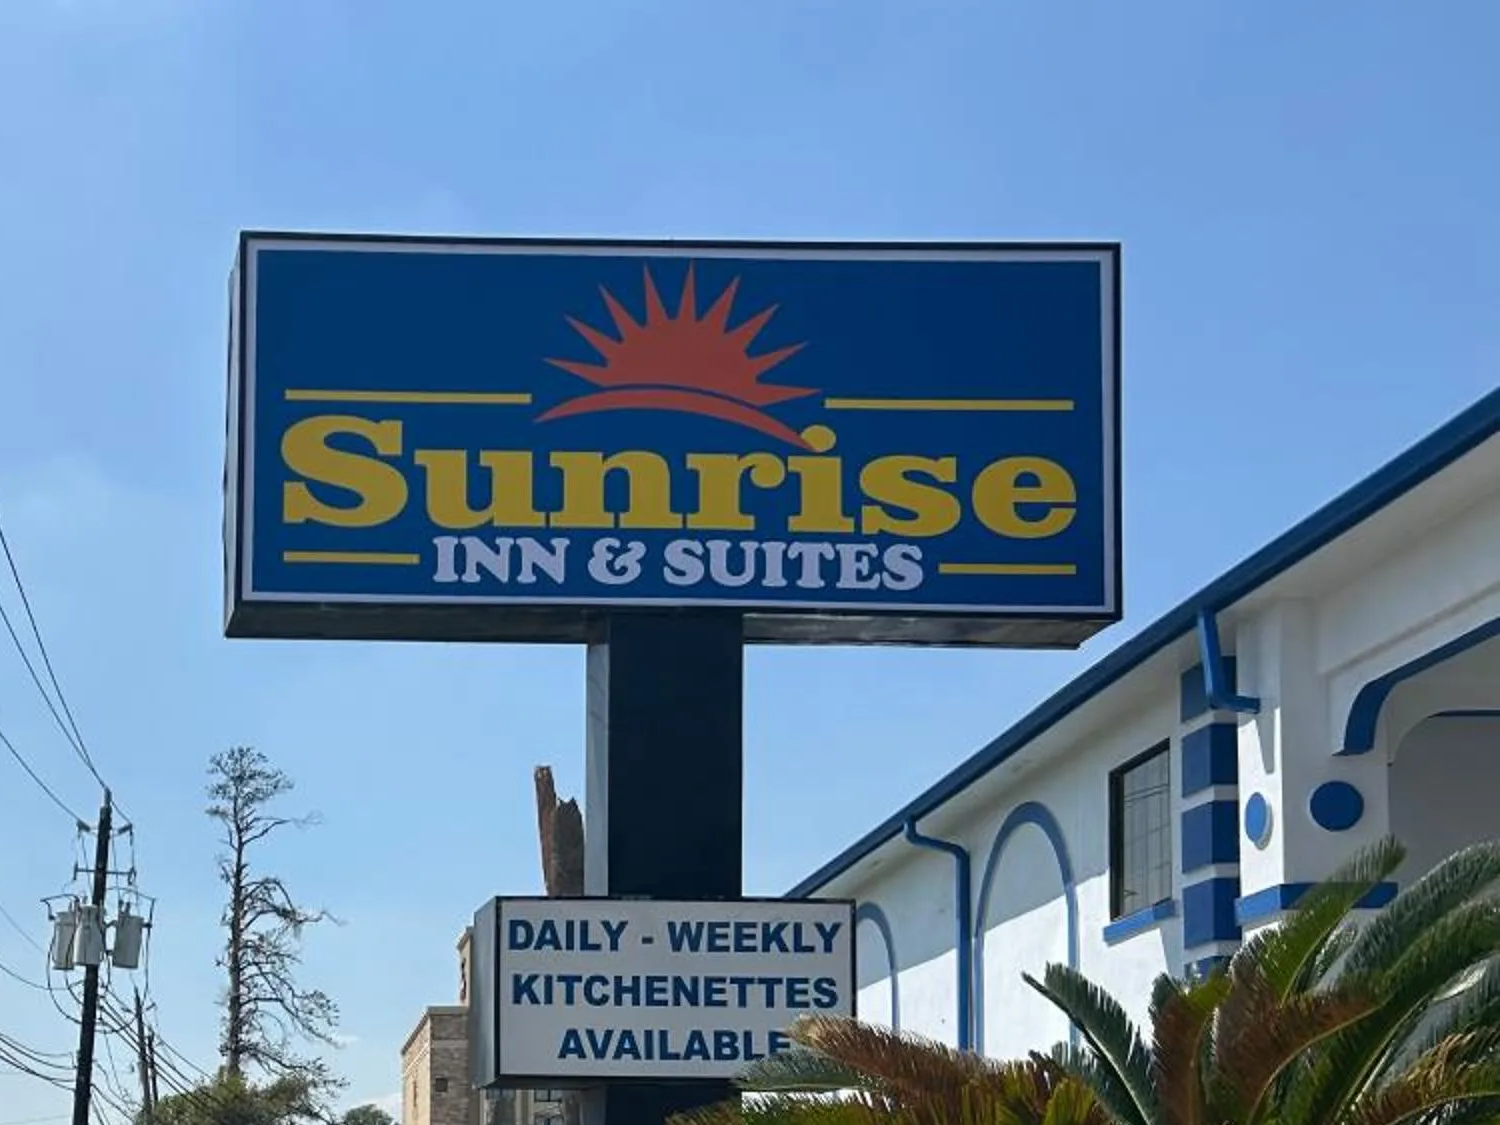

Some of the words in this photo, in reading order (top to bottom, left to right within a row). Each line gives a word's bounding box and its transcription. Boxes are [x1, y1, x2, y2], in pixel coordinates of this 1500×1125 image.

[281, 414, 1077, 539] Sunrise
[432, 536, 570, 584] INN
[588, 537, 645, 583] &
[664, 540, 924, 589] SUITES
[508, 919, 628, 952] DAILY
[667, 921, 843, 954] WEEKLY
[512, 974, 839, 1009] KITCHENETTES
[557, 1028, 790, 1061] AVAILABLE
